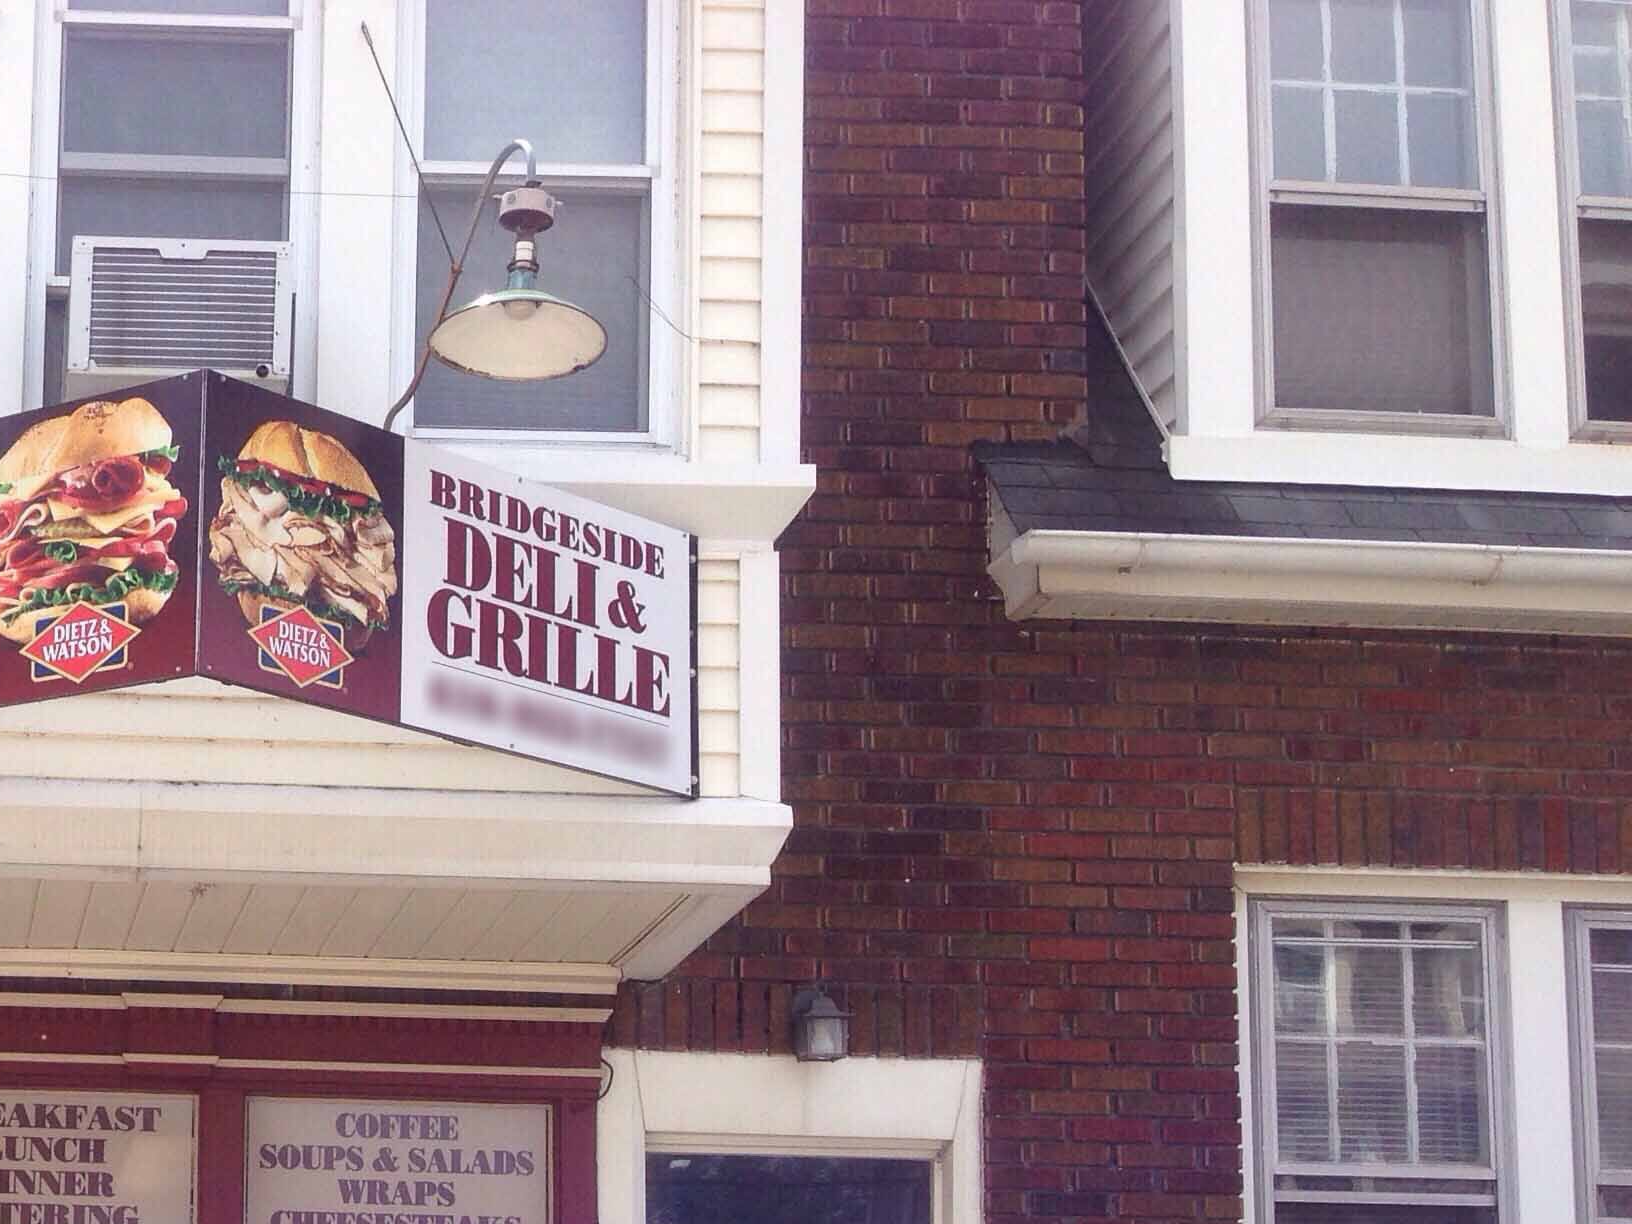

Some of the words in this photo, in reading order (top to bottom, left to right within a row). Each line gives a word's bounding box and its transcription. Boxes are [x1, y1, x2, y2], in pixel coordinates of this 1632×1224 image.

[430, 470, 664, 579] BRIDGESIDE
[443, 516, 600, 629] DELI
[608, 580, 647, 633] &
[54, 619, 99, 643] DIETZ
[100, 617, 112, 634] &
[278, 618, 319, 645] DIETZ
[319, 633, 330, 650] &
[43, 635, 112, 661] WATSON
[269, 637, 331, 668] WATSON
[427, 588, 670, 718] GRILLE
[335, 1112, 458, 1141] COFFEE
[259, 1144, 364, 1171] SOUPS
[372, 1147, 400, 1172] &
[408, 1149, 534, 1176] SALADS
[338, 1179, 456, 1206] WRAPS
